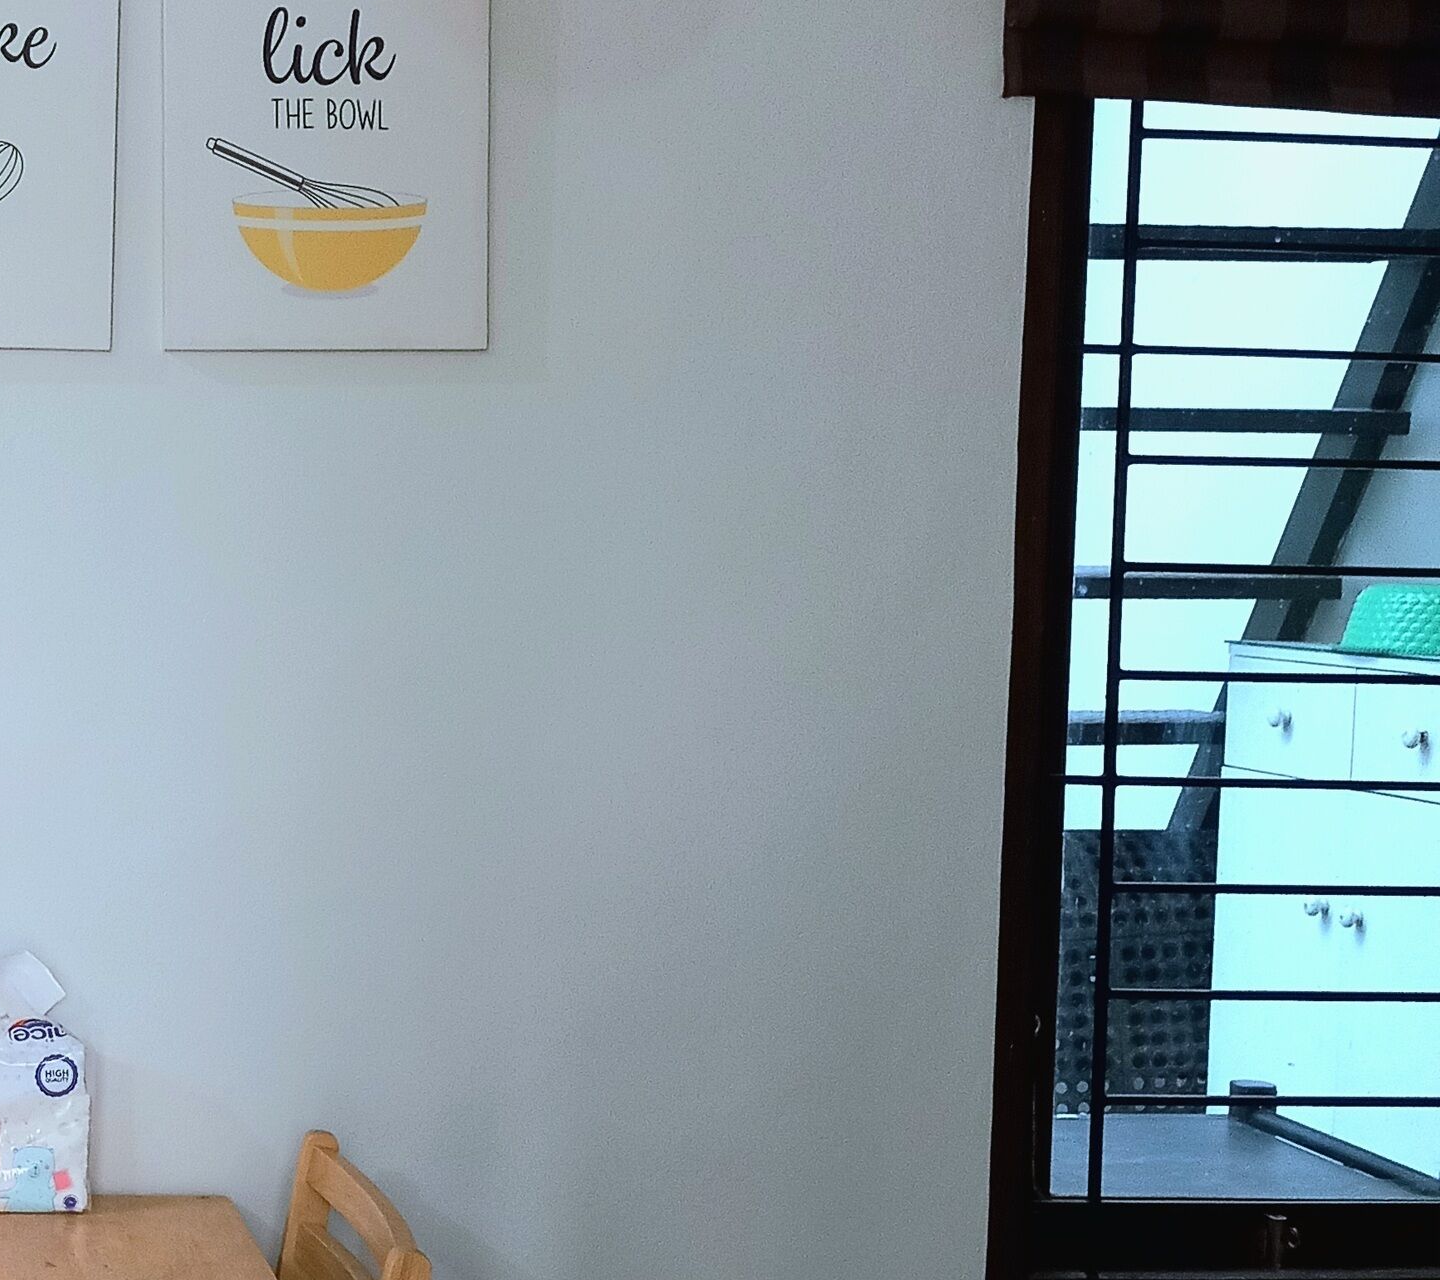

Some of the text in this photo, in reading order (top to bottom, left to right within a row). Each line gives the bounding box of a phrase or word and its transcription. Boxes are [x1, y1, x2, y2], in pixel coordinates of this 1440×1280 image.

[262, 6, 397, 86] lick
[271, 98, 390, 131] THE BOWL
[45, 1069, 70, 1079] HIGH
